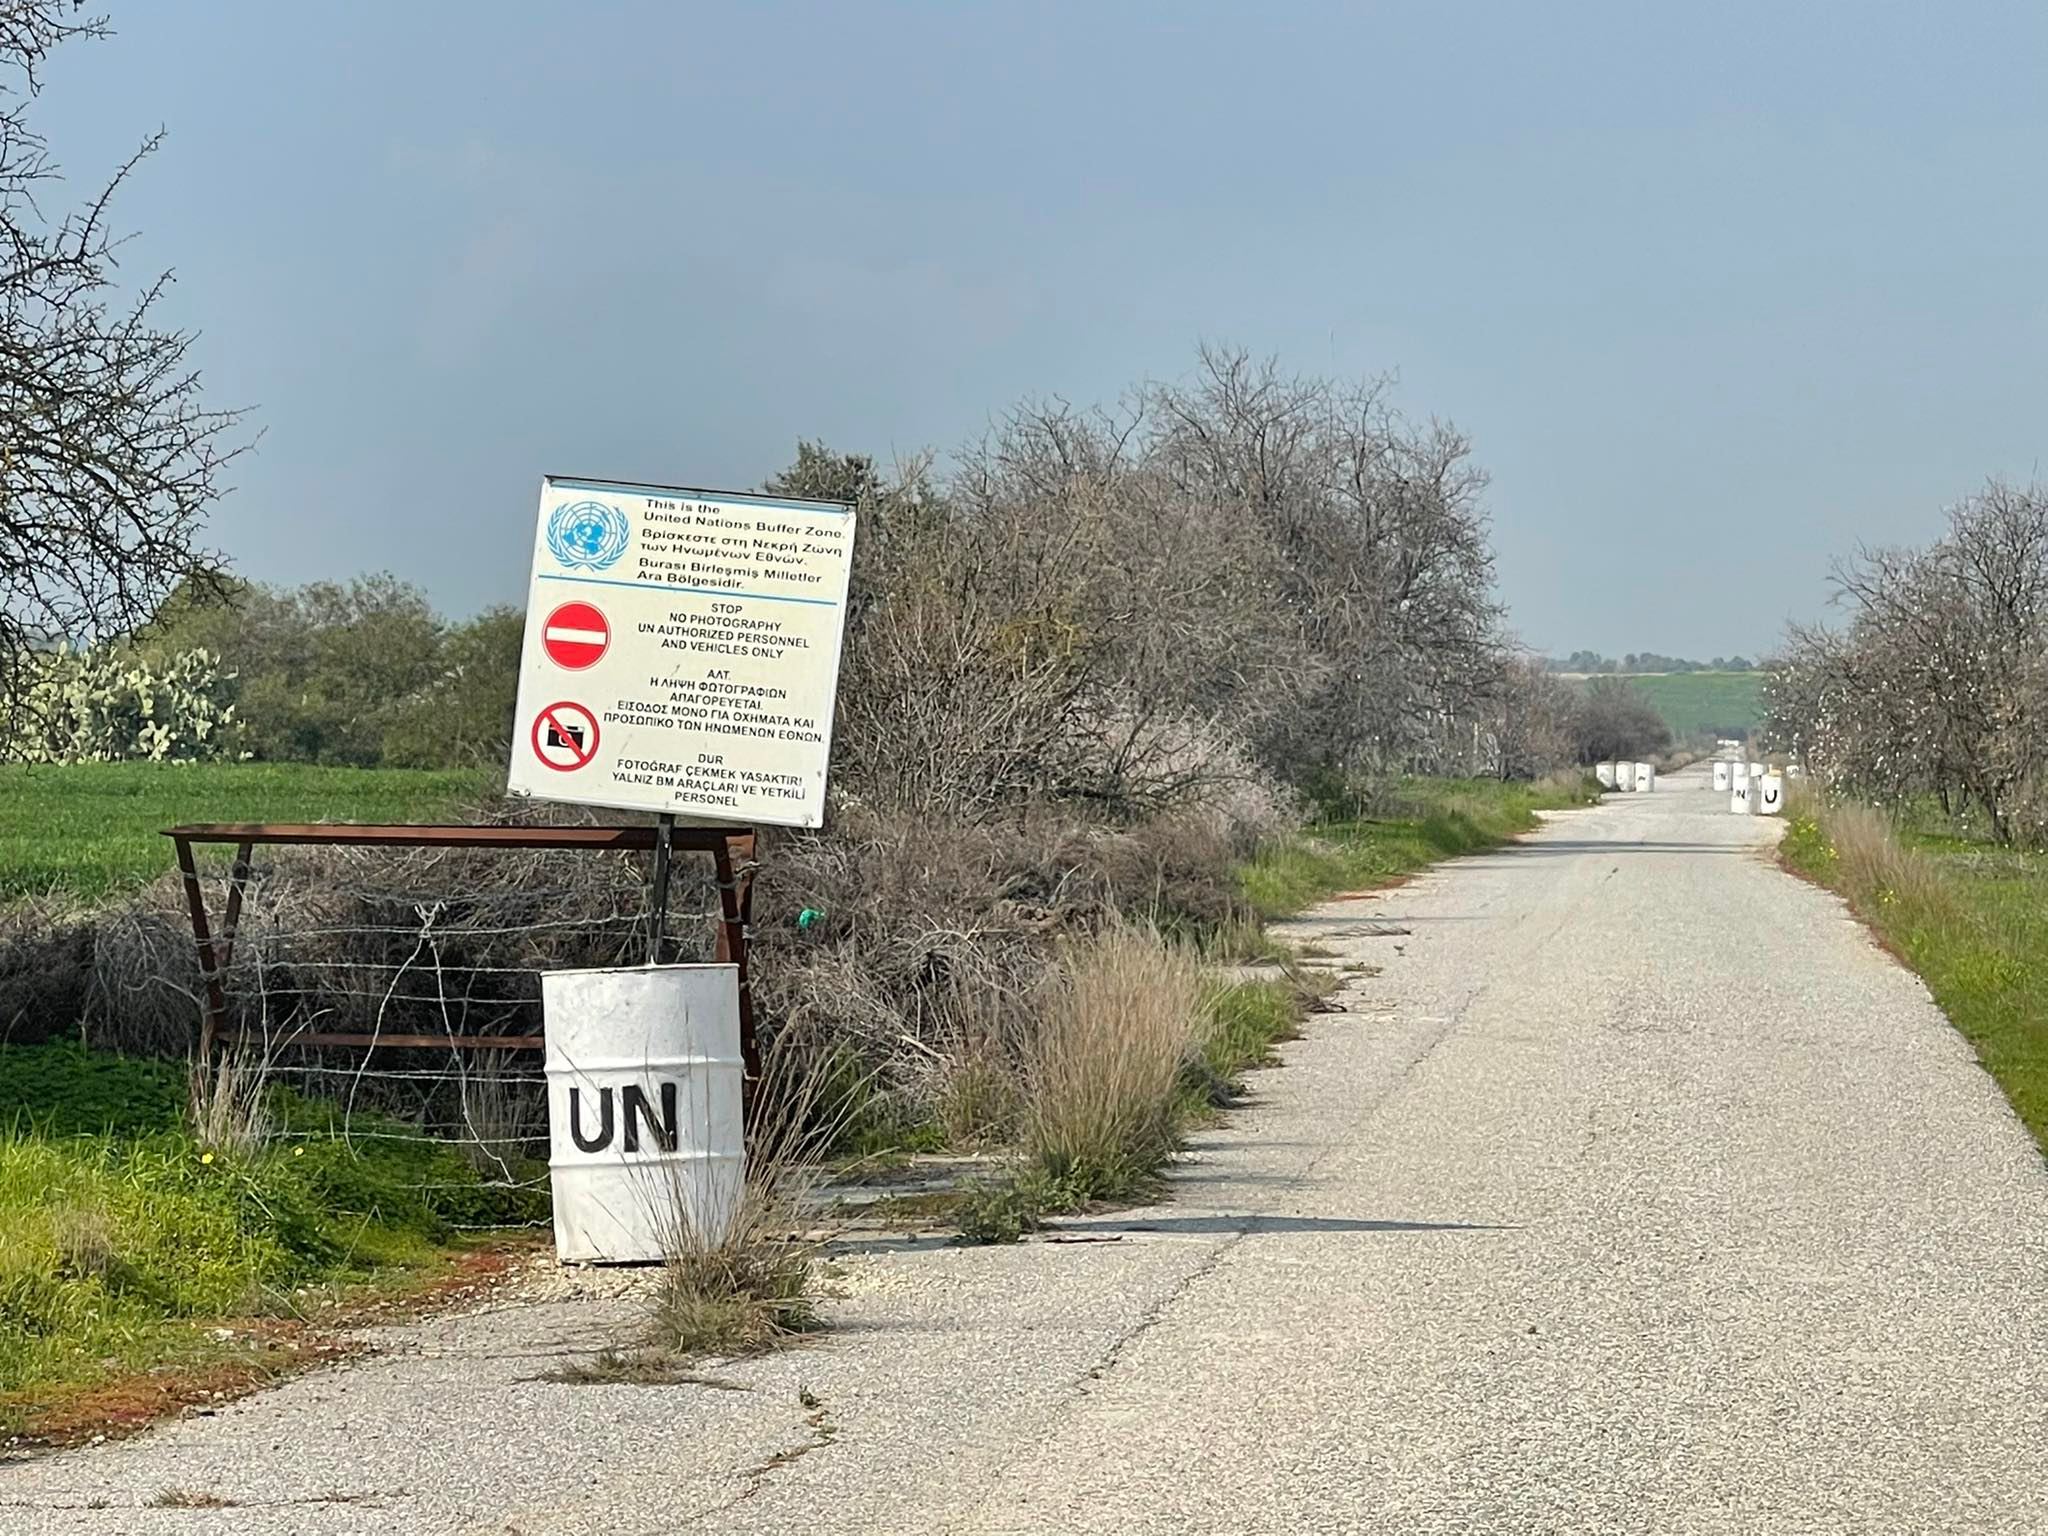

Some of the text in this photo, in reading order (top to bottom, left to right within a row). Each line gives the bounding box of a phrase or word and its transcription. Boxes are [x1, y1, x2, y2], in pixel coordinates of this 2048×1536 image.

[646, 498, 720, 514] This is the
[644, 511, 846, 539] United Nations Buffer Zone.
[641, 543, 807, 566] των Ηνωμένων Εθνών.
[642, 528, 842, 558] Βρίσκεστε στη Νεκρή Ζώνη
[637, 570, 745, 589] Ara Bölgesidir.
[639, 557, 822, 583] Burası Birleşmiş Milletler
[711, 603, 743, 614] STOP
[670, 612, 782, 631] NO PHOTOGRAPHY
[638, 622, 810, 648] UN AUTHORIZED PERSONNEL
[661, 638, 784, 659] AND VEHICLES ONLY
[650, 677, 787, 699] Η ΛΗΨΗ ΦΩΤΟΓΡΑΦΙΩΝ
[603, 712, 674, 728] ΠΡΟΣΩΠΙΚΟ
[677, 719, 702, 731] ΤΩΝ
[705, 722, 775, 738] ΗΝΩΜΕΝΩΝ
[617, 700, 814, 729] ΕΙΣΟΔΟΣ ΜΟΝΟ ΓΙΑ ΟΧΗΜΑΤΑ ΚΑΙ
[698, 753, 723, 765] DUR
[617, 759, 802, 786] FOTOĞRAF ÇEKMEK YASAKTIR!
[612, 771, 806, 800] YALNIZ BM ARAÇLARI VE YETKİLİ
[1765, 789, 1778, 804] U
[675, 791, 739, 807] PERSONEL
[569, 1082, 679, 1155] UN
